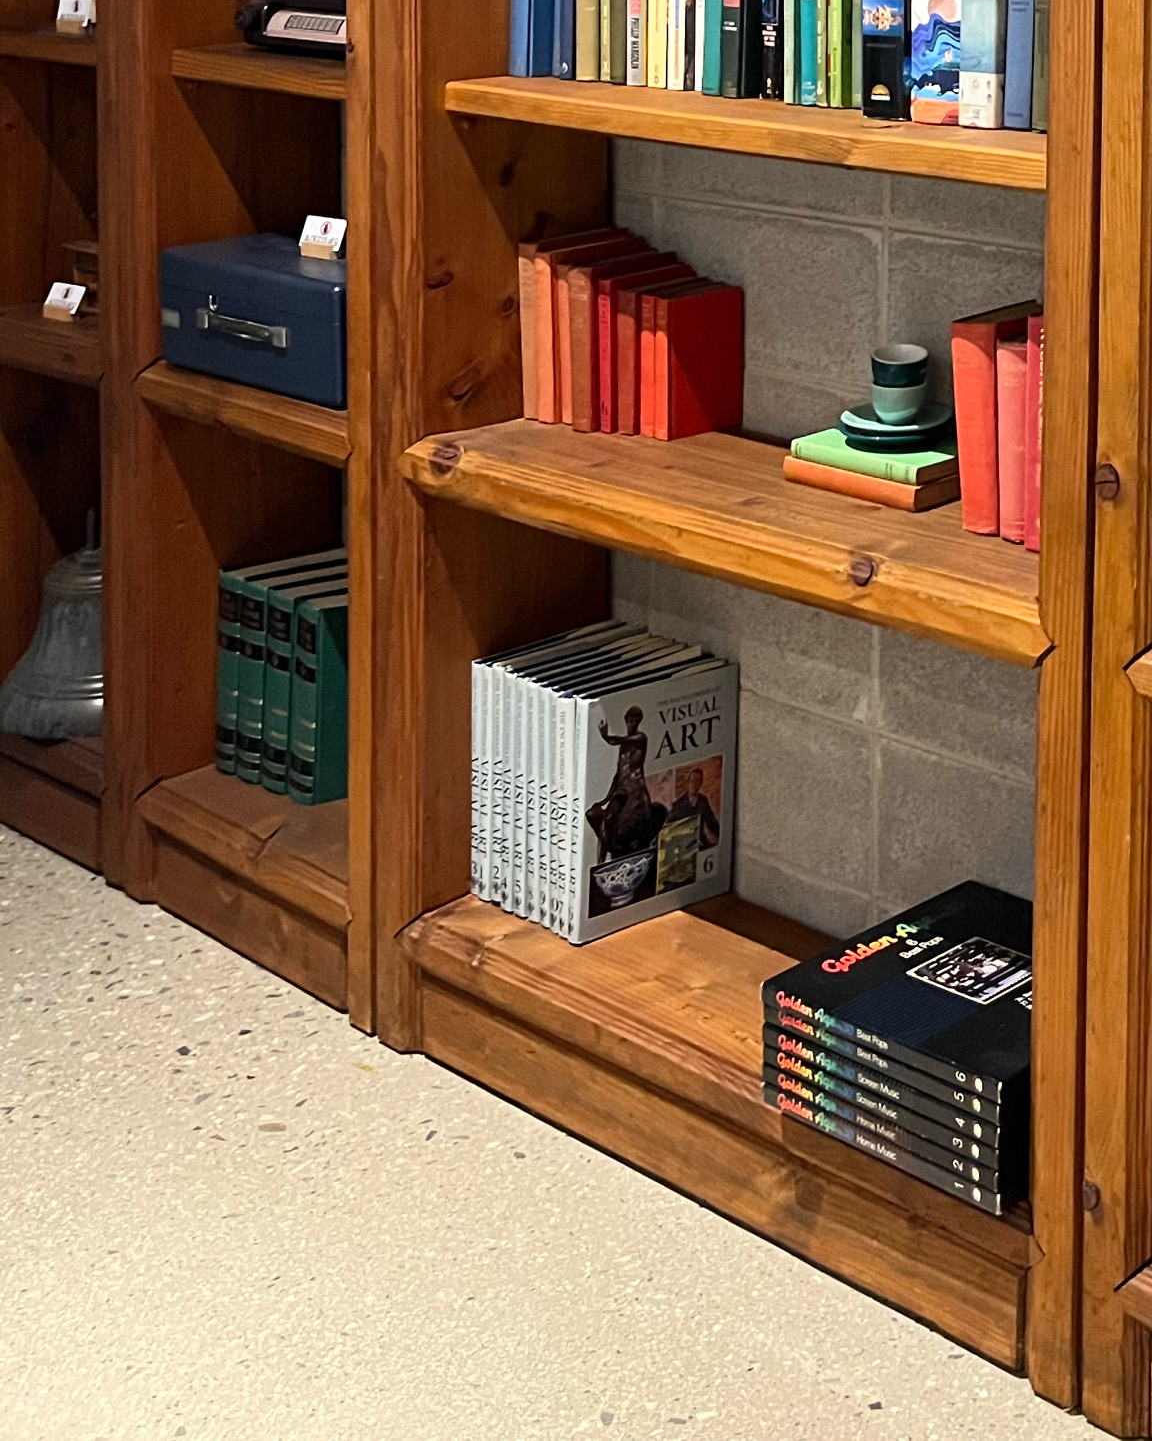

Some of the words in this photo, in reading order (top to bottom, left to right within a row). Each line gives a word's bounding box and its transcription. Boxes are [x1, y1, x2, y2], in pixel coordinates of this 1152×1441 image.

[657, 696, 722, 725] VISUAL
[655, 715, 720, 759] ART
[704, 855, 713, 873] 6
[821, 935, 898, 973] Golden
[919, 936, 944, 949] Pops
[776, 991, 813, 1017] Golden
[856, 1029, 871, 1040] Best
[872, 1035, 888, 1050] Pops
[777, 1034, 814, 1061] Golden
[858, 1073, 879, 1089] Screen
[880, 1083, 900, 1100] Music
[956, 1071, 967, 1081] 6
[777, 1052, 813, 1080] Golden
[856, 1092, 877, 1108] Screen
[878, 1103, 897, 1119] Music
[778, 1074, 813, 1101] Golden
[856, 1115, 875, 1131] Home
[877, 1123, 896, 1140] Music
[956, 1117, 965, 1127] 4
[777, 1094, 813, 1121] Golden
[856, 1134, 875, 1150] Home
[876, 1144, 897, 1160] Music
[953, 1137, 963, 1147] 3
[954, 1181, 964, 1189] 1
